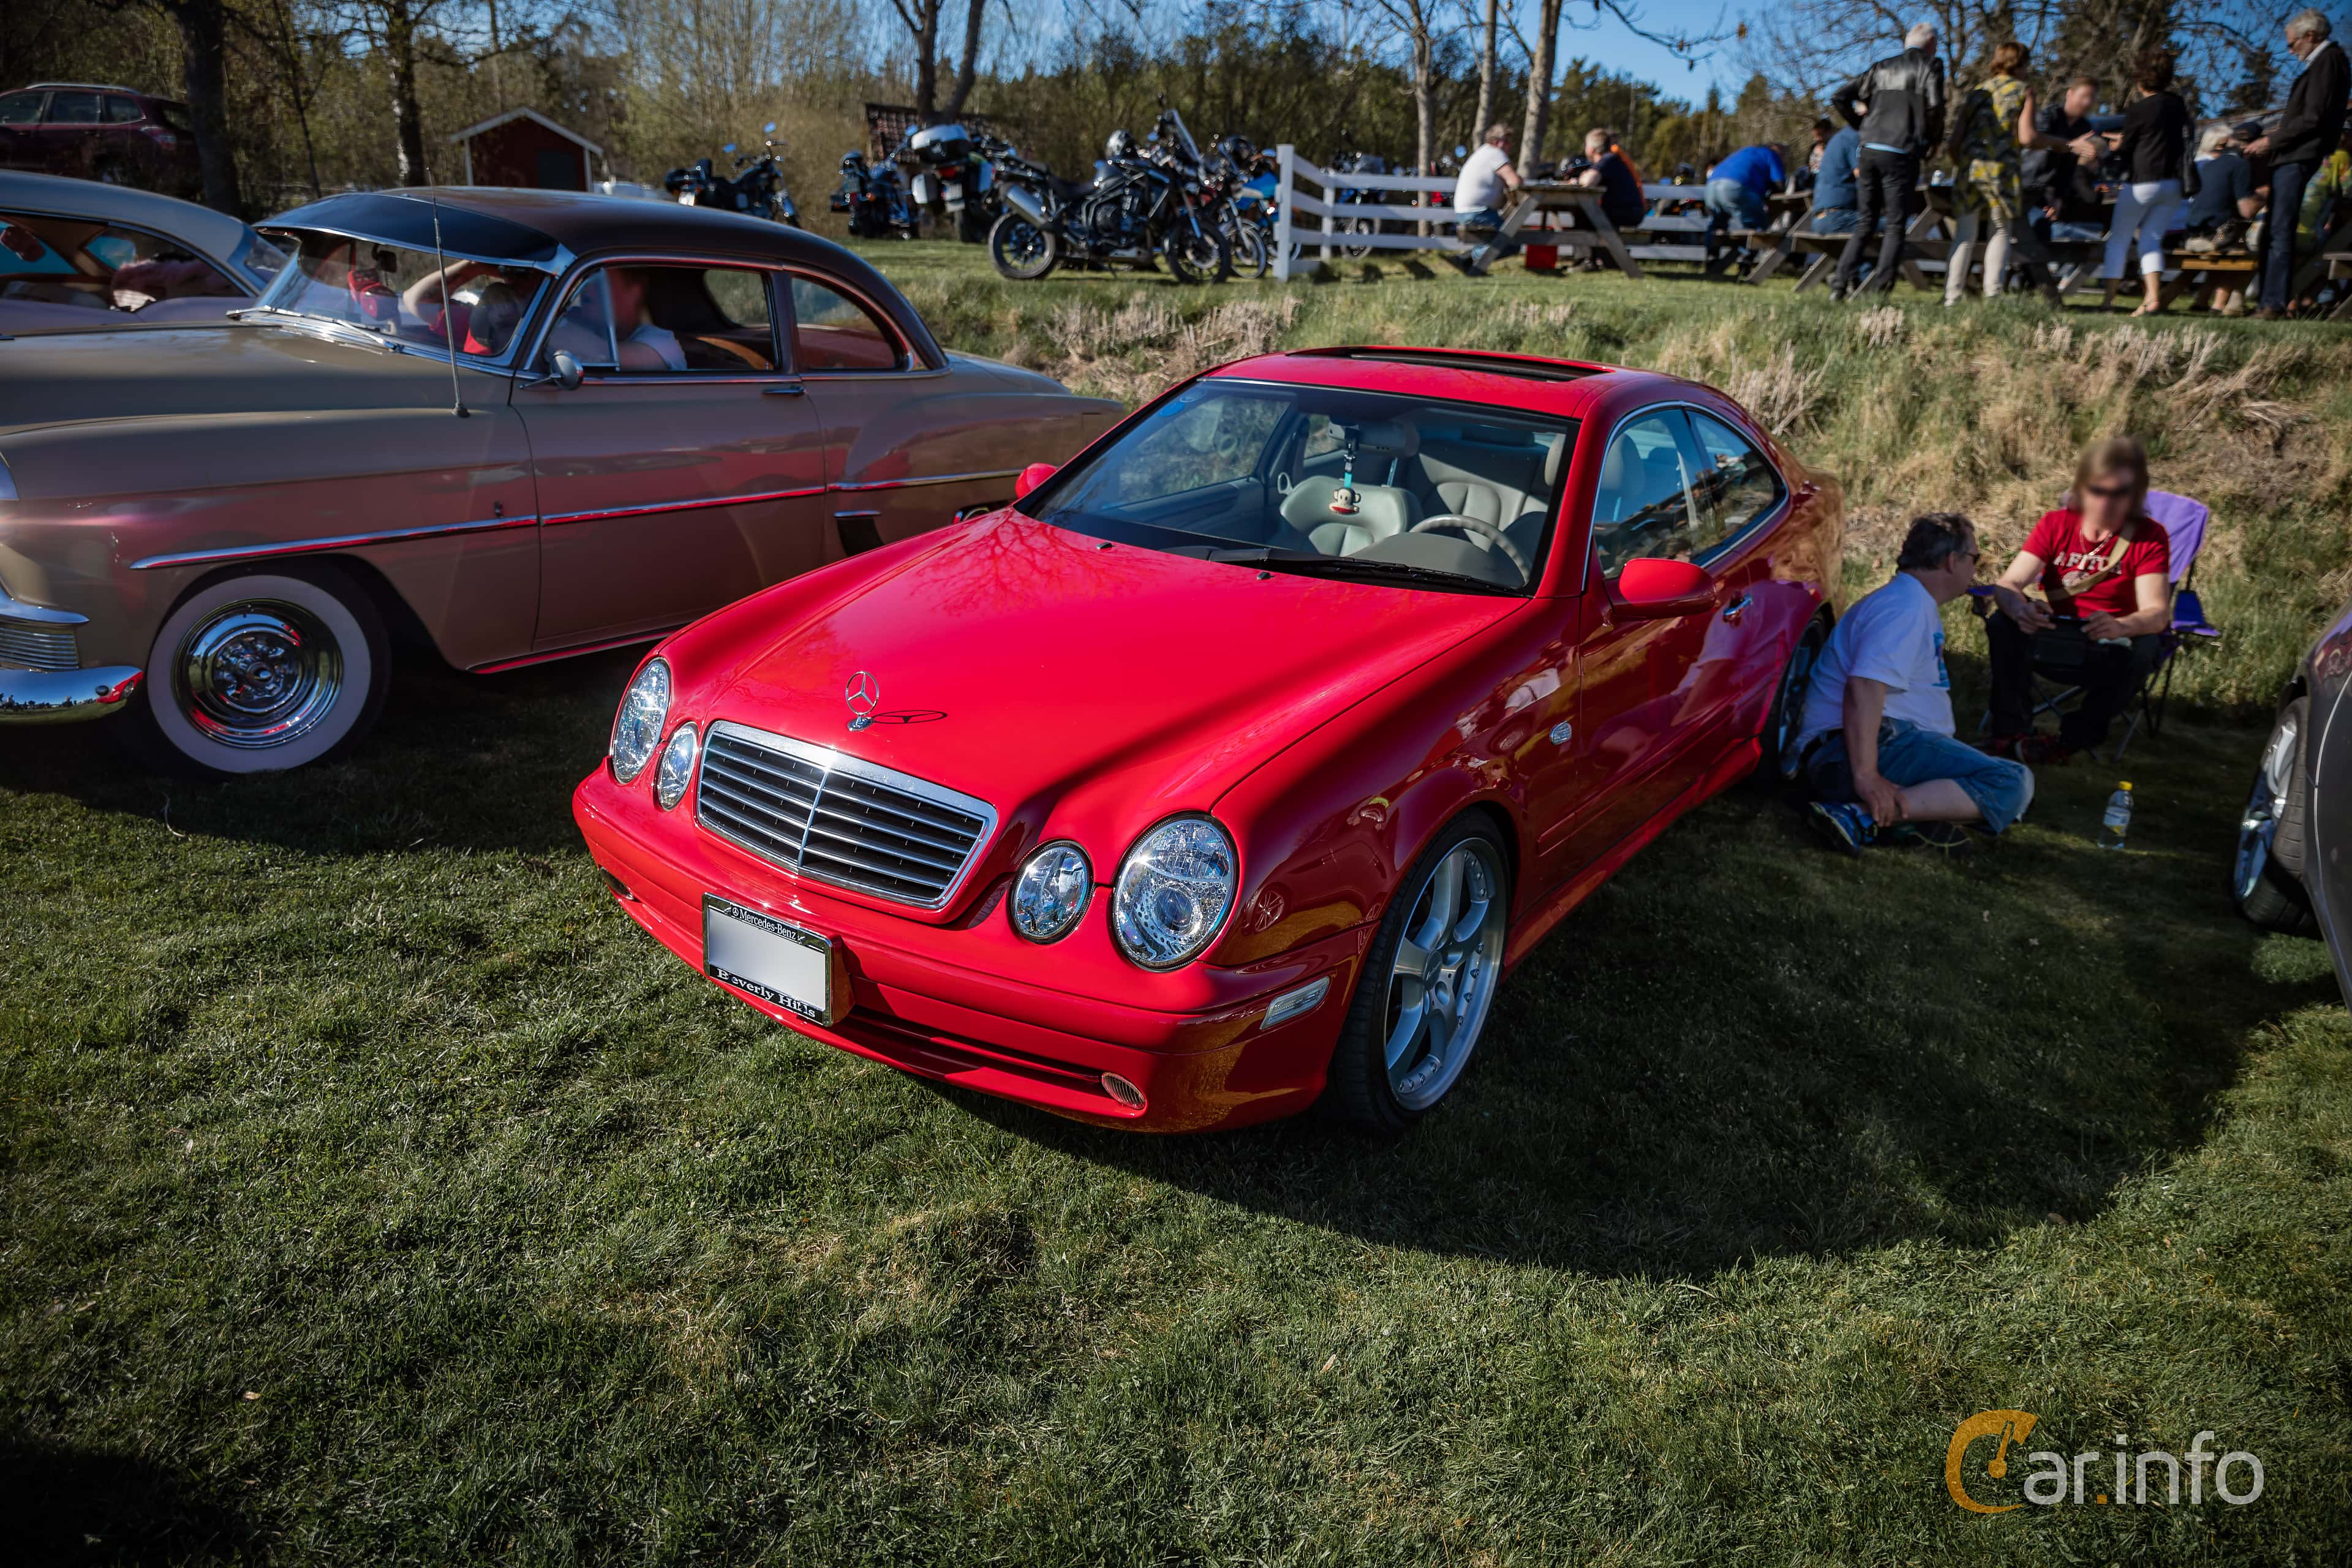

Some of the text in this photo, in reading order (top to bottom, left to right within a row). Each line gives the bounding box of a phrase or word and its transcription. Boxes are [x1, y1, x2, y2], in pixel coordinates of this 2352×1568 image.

[739, 908, 797, 940] Mercedes-Benz
[717, 968, 816, 1018] Beverly Hills
